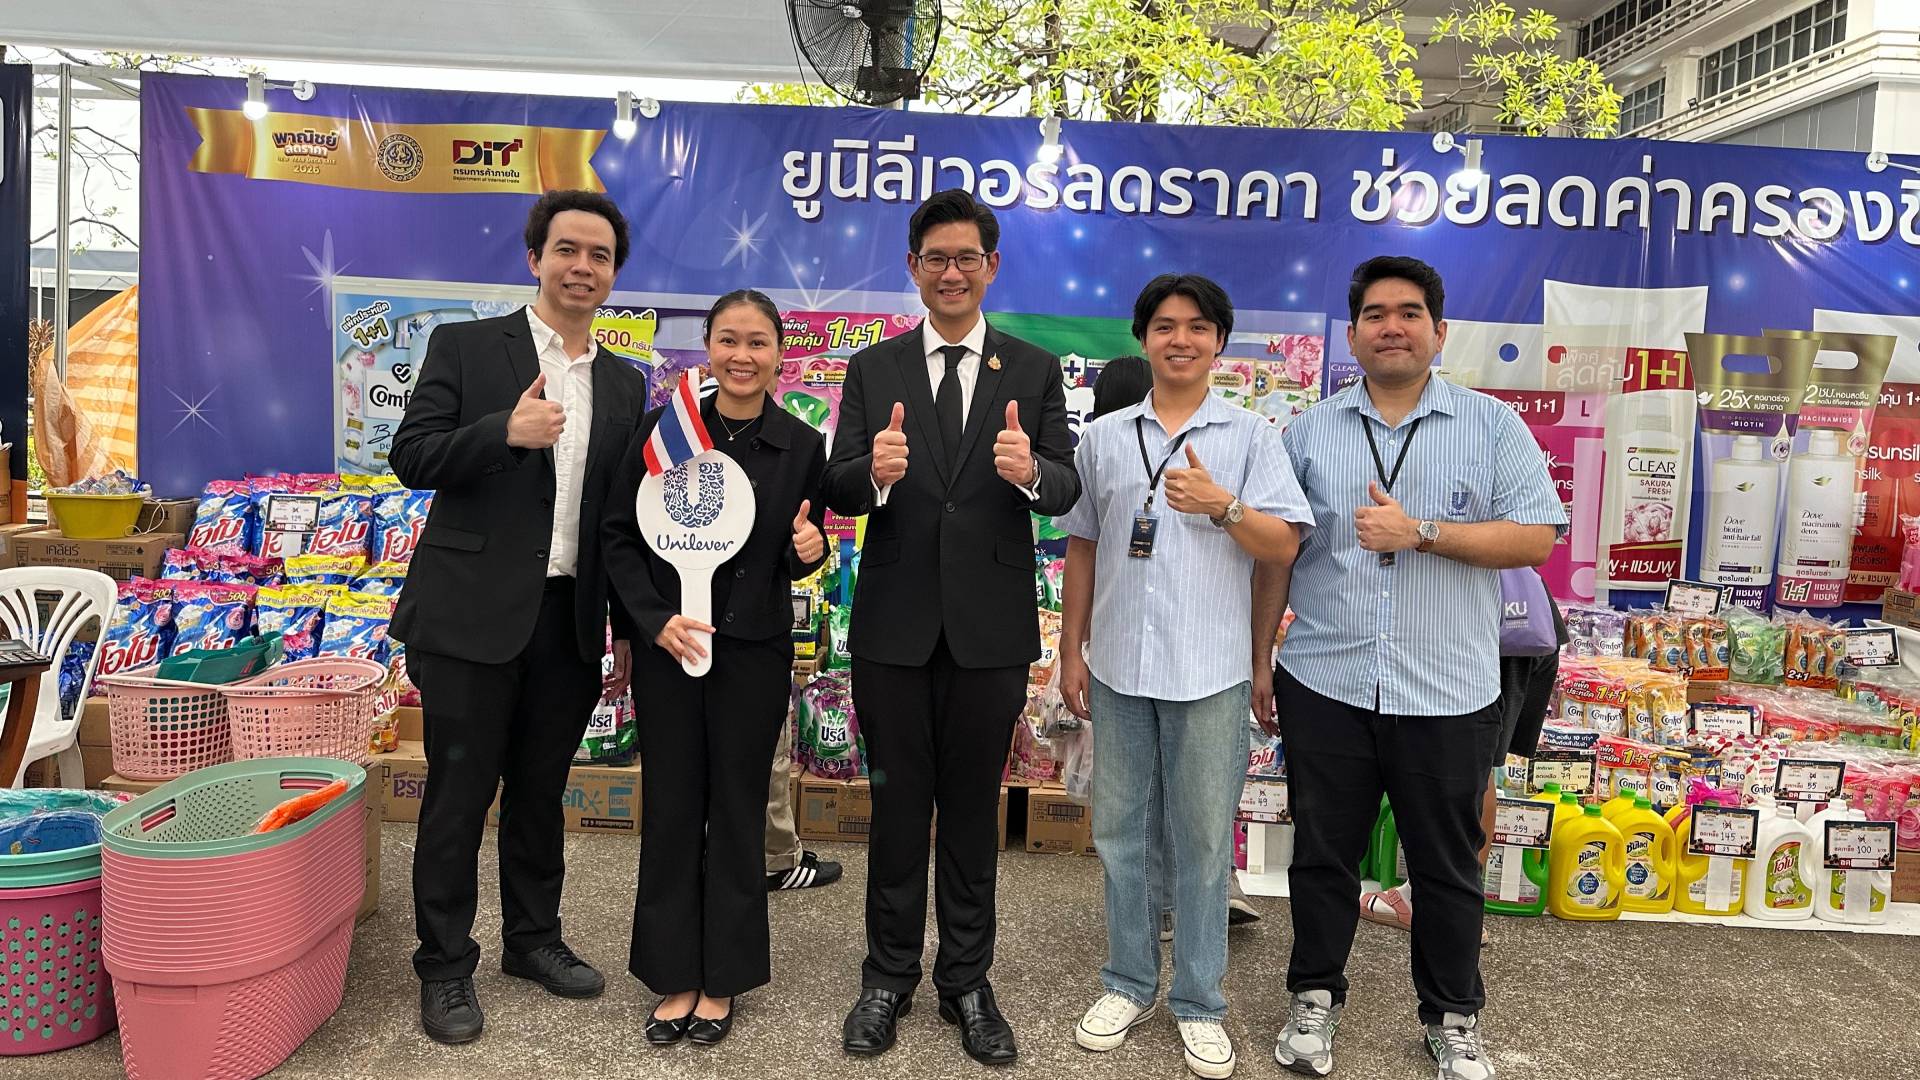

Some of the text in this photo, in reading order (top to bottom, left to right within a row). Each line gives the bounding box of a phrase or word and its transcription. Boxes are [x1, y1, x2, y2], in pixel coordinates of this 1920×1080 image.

[273, 129, 339, 148] พาณิชย์
[285, 144, 328, 157] ลดราคา
[294, 164, 321, 174] 2026
[453, 168, 520, 178] กรมการค้าภายใน
[782, 134, 1318, 219] ยูนิลีเวอรลดราคา
[354, 317, 389, 347] 1+1
[595, 329, 631, 347] 500
[827, 317, 885, 349] 1+1
[1330, 364, 1358, 372] CLEAR
[1637, 350, 1687, 389] 1+1
[369, 384, 412, 411] Comf
[1804, 384, 1818, 404] 2
[1906, 391, 1920, 406] 1+
[1535, 398, 1557, 413] 1+1
[1581, 400, 1590, 417] L
[1868, 445, 1920, 461] sunsil
[1628, 456, 1676, 474] CLEAR
[1854, 467, 1881, 481] nsilk
[1640, 479, 1672, 488] SAKURA
[1647, 487, 1672, 495] FRESH
[1802, 510, 1823, 519] Dove
[188, 517, 245, 548] โอโม
[309, 517, 369, 553] โอโม
[382, 518, 427, 562] โอโ
[657, 533, 734, 552] Unilever
[1630, 560, 1676, 578] แชมพู
[1735, 589, 1762, 599] แชมพู
[1814, 583, 1840, 593] แชมพู
[1504, 601, 1528, 616] KU
[1573, 638, 1594, 648] Comfo
[1787, 670, 1810, 681] 2+1
[1591, 709, 1623, 720] Comfort
[821, 725, 846, 742] บรีส
[1560, 772, 1571, 781] 79
[1722, 768, 1746, 780] omfo
[1750, 783, 1775, 795] Comfor
[1513, 825, 1528, 833] 259
[1721, 832, 1736, 841] 145
[1857, 845, 1872, 854] 100
